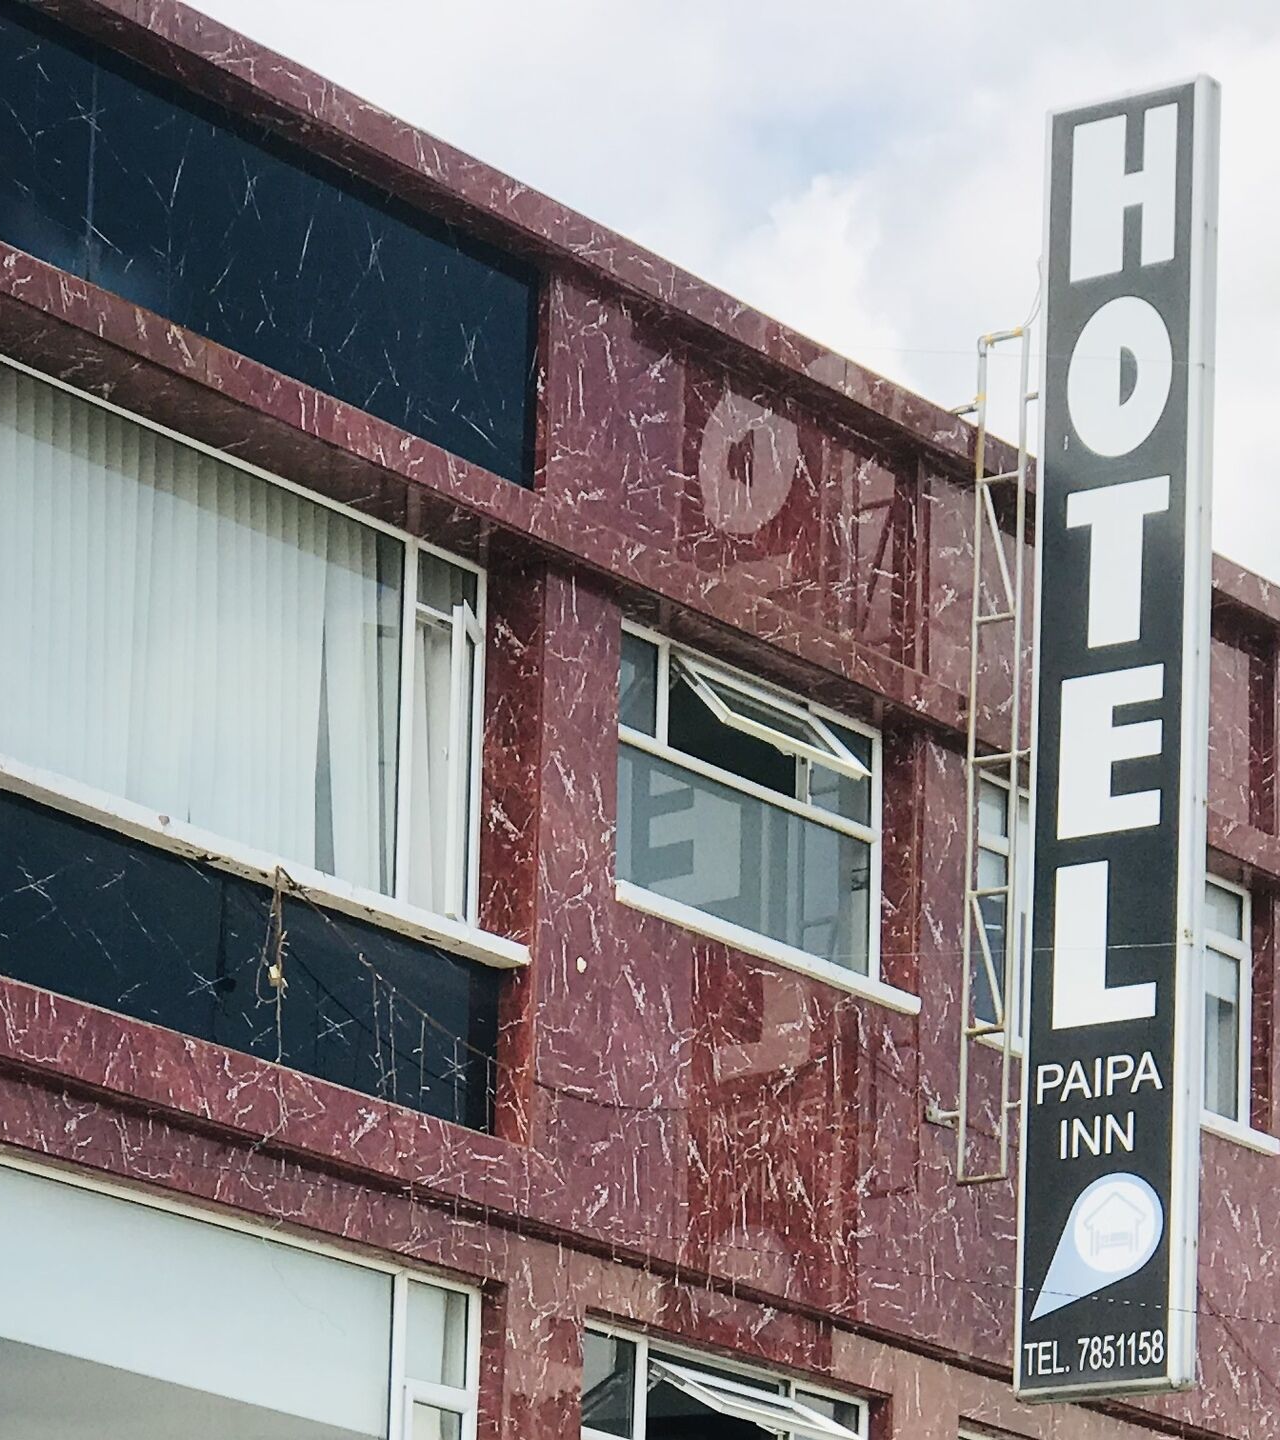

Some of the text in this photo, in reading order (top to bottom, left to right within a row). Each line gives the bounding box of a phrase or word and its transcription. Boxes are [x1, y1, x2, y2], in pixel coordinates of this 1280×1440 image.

[1052, 102, 1178, 1030] HOTEL
[1036, 1051, 1164, 1105] PAIPA
[1059, 1111, 1135, 1160] INN
[1024, 1329, 1165, 1376] TEL. 7851158
